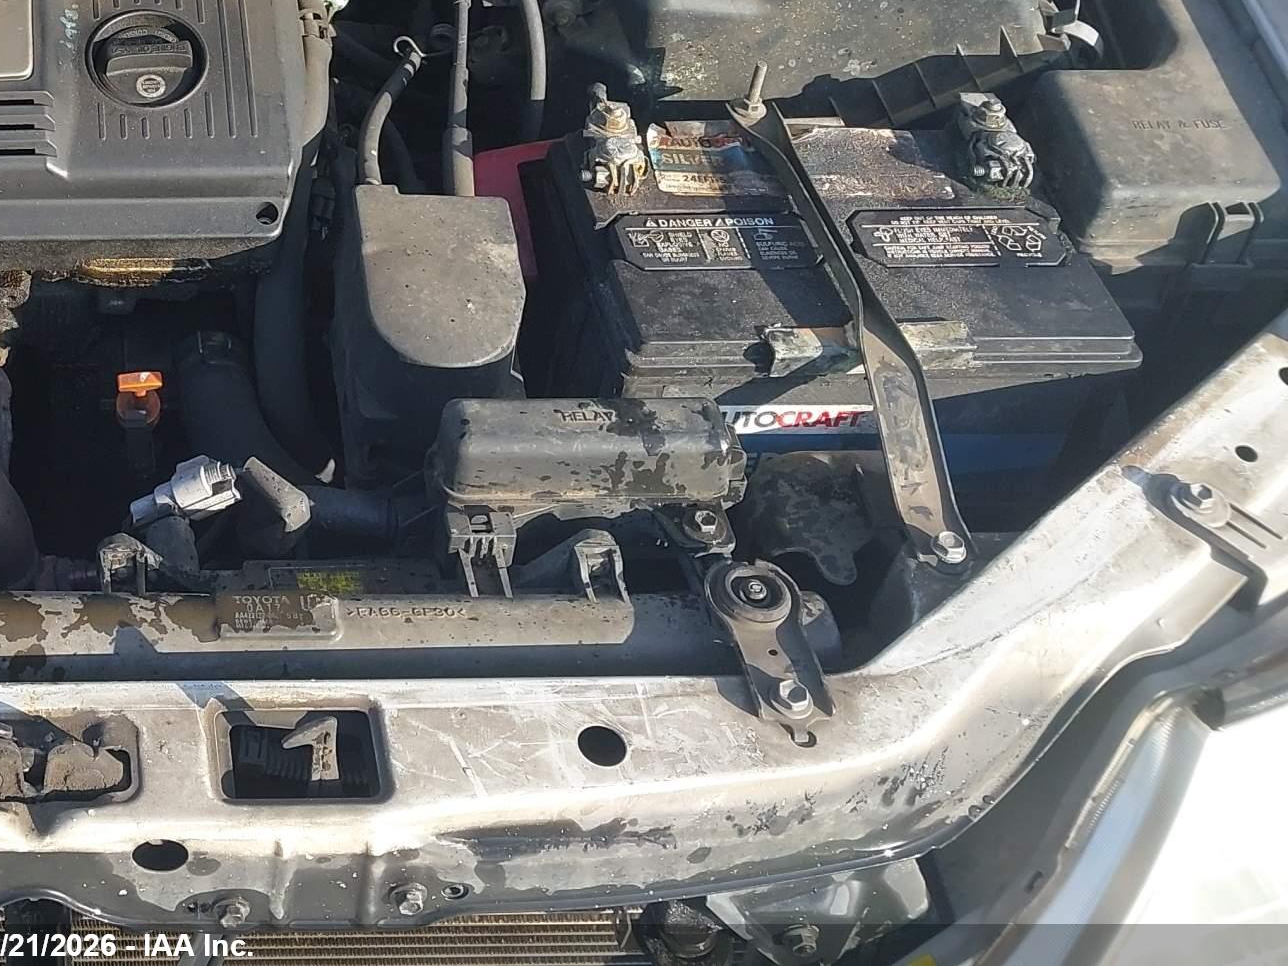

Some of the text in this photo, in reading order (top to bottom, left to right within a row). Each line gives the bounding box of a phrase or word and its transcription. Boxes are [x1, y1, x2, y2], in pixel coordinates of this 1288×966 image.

[1132, 120, 1171, 130] RELAY
[1192, 119, 1227, 130] FUSE
[659, 218, 774, 227] DANGER POISON
[722, 411, 865, 428] UTOCRAFT
[232, 595, 291, 605] TOYOTA
